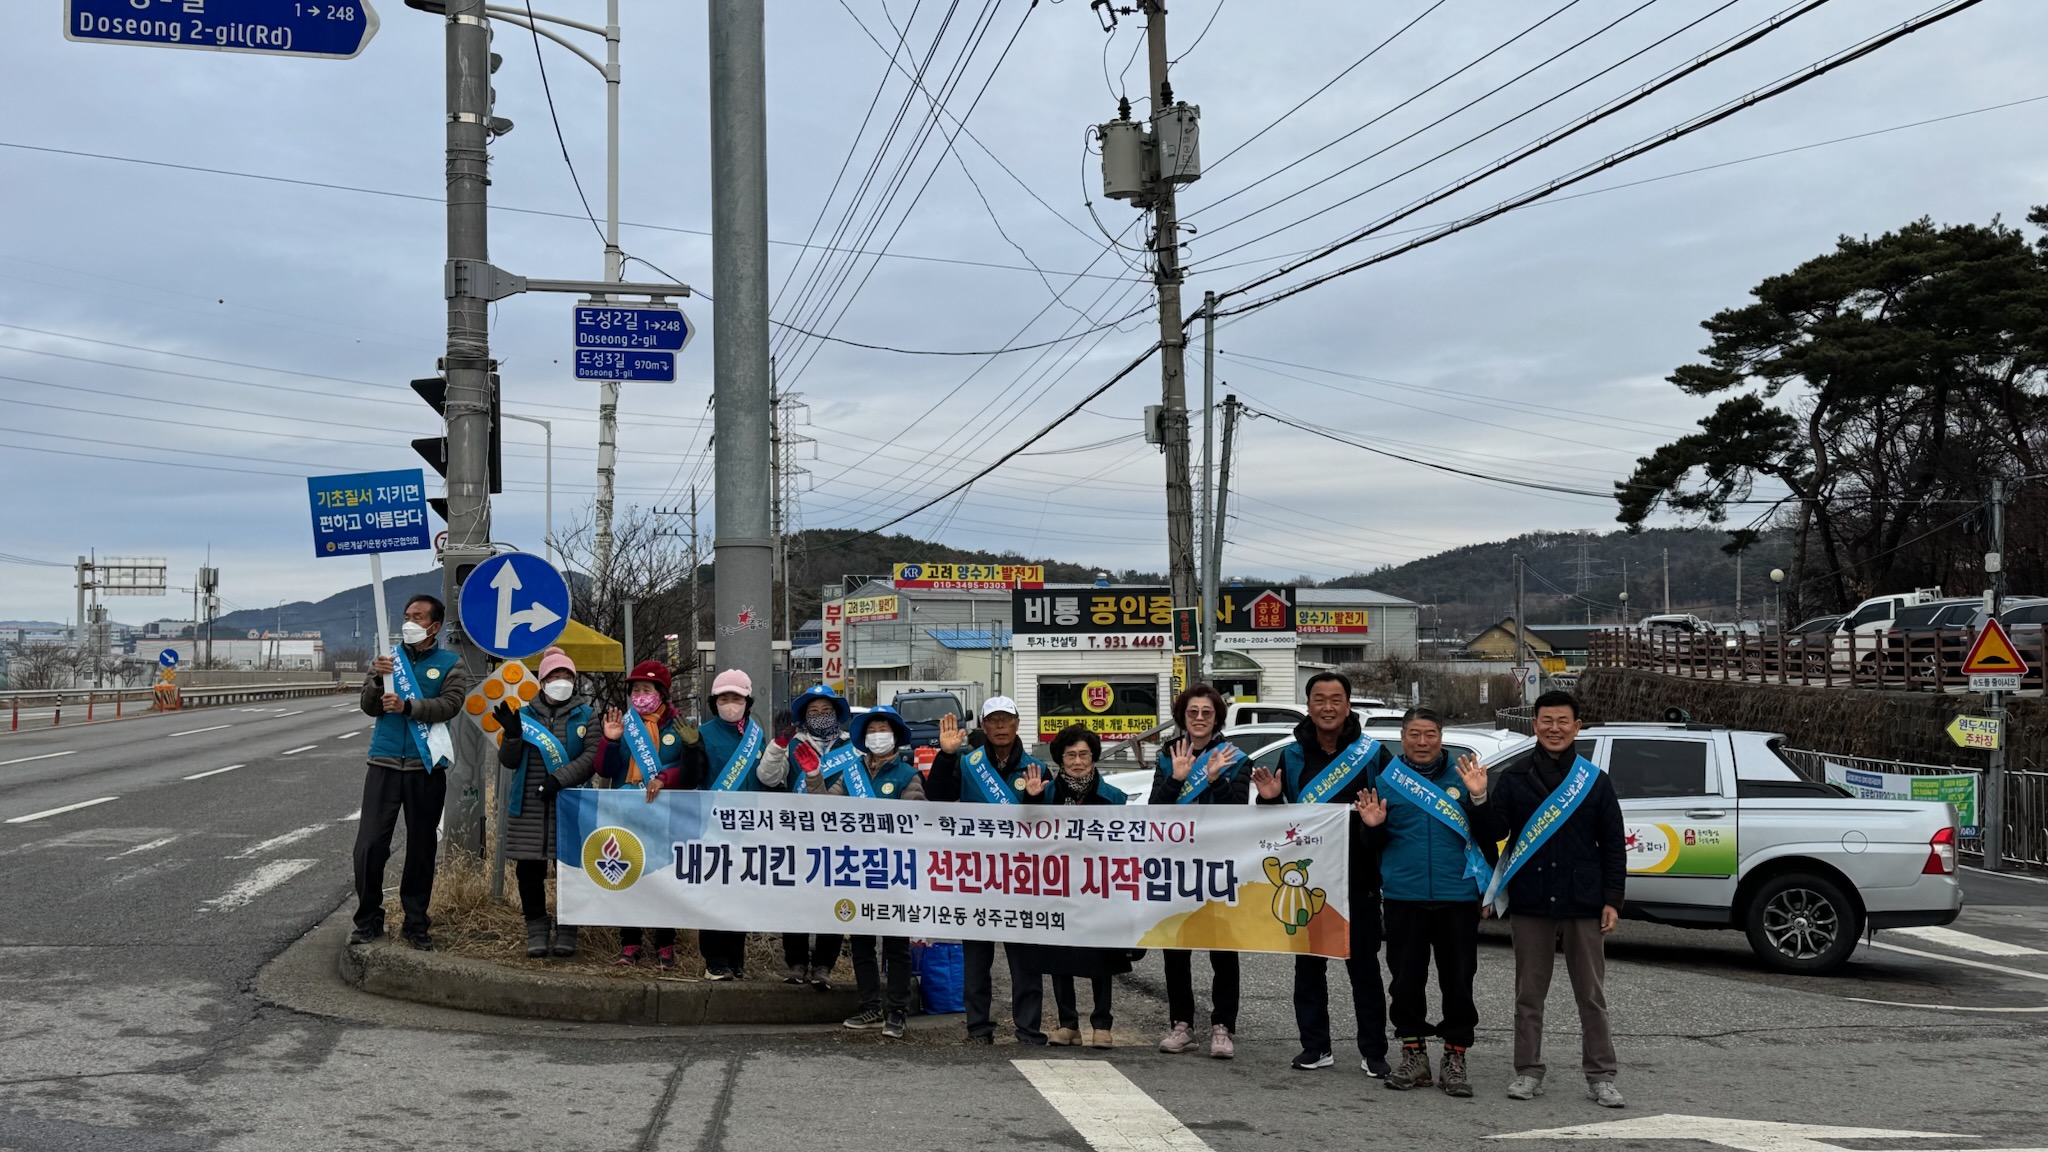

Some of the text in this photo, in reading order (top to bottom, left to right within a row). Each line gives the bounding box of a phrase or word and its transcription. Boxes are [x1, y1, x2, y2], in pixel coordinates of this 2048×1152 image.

[326, 5, 355, 21] 248
[79, 12, 293, 49] Doseong 2-gil(Rd)
[579, 311, 638, 331] 도성2길
[660, 321, 681, 331] 248
[580, 333, 657, 347] Doseong 2-gil
[579, 352, 660, 370] 도성3길 970m
[579, 368, 633, 378] Doseong 3-gil
[317, 484, 420, 508] 기초질서 지키면
[320, 508, 423, 533] 편하고 아름답다
[337, 536, 420, 551] 바르게살기운동성주군협의회
[904, 565, 1039, 581] KR 고려 양수기·발전기
[933, 581, 1007, 589] 010-3495-0303
[848, 601, 859, 614] 고려
[1024, 595, 1235, 626] 비룡 공인중사
[1258, 602, 1281, 615] 공장
[1258, 614, 1281, 627] 전문
[1299, 611, 1365, 625] 양수기·발전기
[825, 605, 842, 679] 부동산
[1027, 635, 1165, 648] 투자·컨설팅 T. 931 4449
[1972, 678, 2017, 687] 속도를 줄이시오
[1086, 685, 1110, 708] 땅
[1044, 718, 1069, 731] 전원주택
[1092, 718, 1105, 731] 경매
[1109, 718, 1123, 731] 개발
[1127, 718, 1154, 731] 투자상담
[1958, 718, 1998, 734] 원두식당
[1965, 733, 1994, 747] 주차장
[975, 763, 1010, 805] 바르게살기운
[1317, 762, 1352, 797] 대한민국의
[1391, 768, 1438, 805] 바르게살기가
[1556, 765, 1590, 810] 바르게살기가
[778, 810, 816, 832] 확립
[938, 816, 1061, 841] 학교폭력NO!
[1064, 819, 1196, 843] 과속운전NO!
[1526, 804, 1562, 844] 대한민국의
[673, 842, 1239, 903] 내가 지킨 기초질서 선진사회의 시작입니다
[861, 903, 1066, 931] 바르게살기운동 성주군협의회
